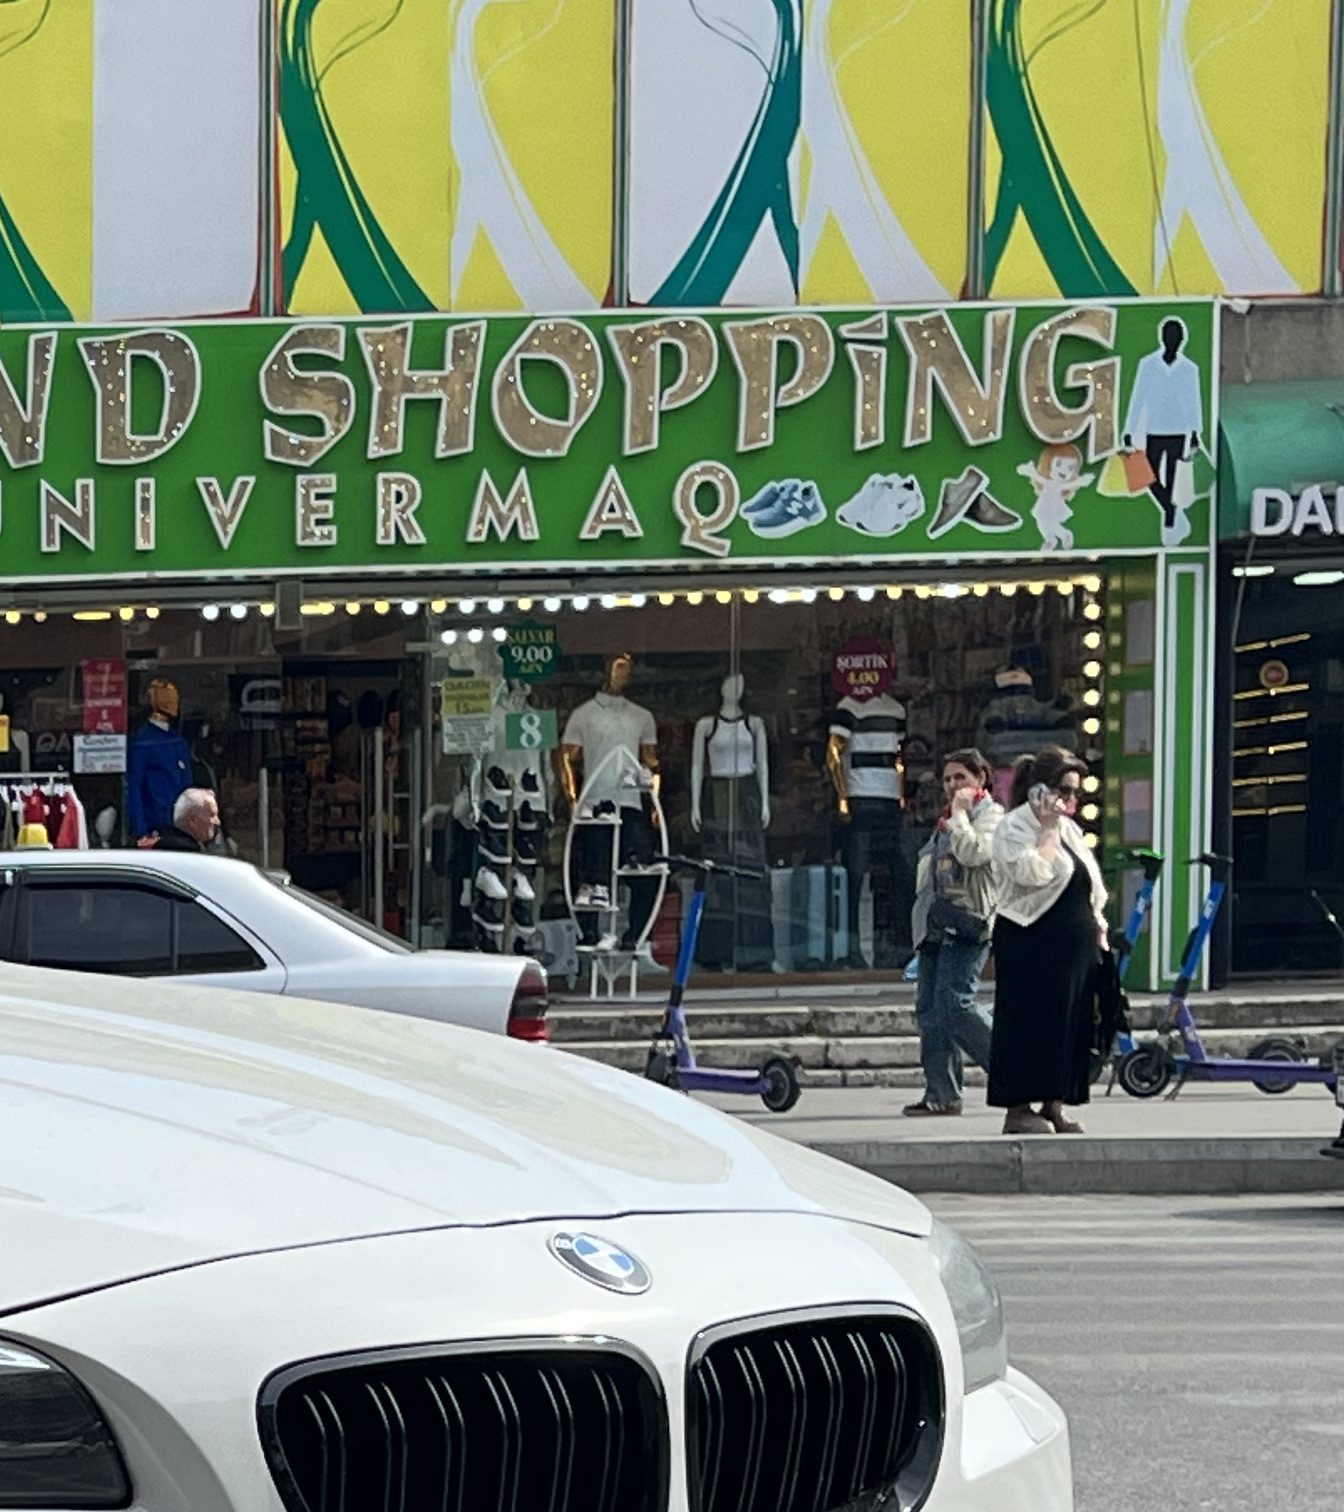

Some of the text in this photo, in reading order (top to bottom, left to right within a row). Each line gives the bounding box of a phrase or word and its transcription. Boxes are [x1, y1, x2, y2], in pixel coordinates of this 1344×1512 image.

[1250, 484, 1344, 537] DA
[511, 645, 553, 664] 9.00
[519, 713, 543, 748] 8
